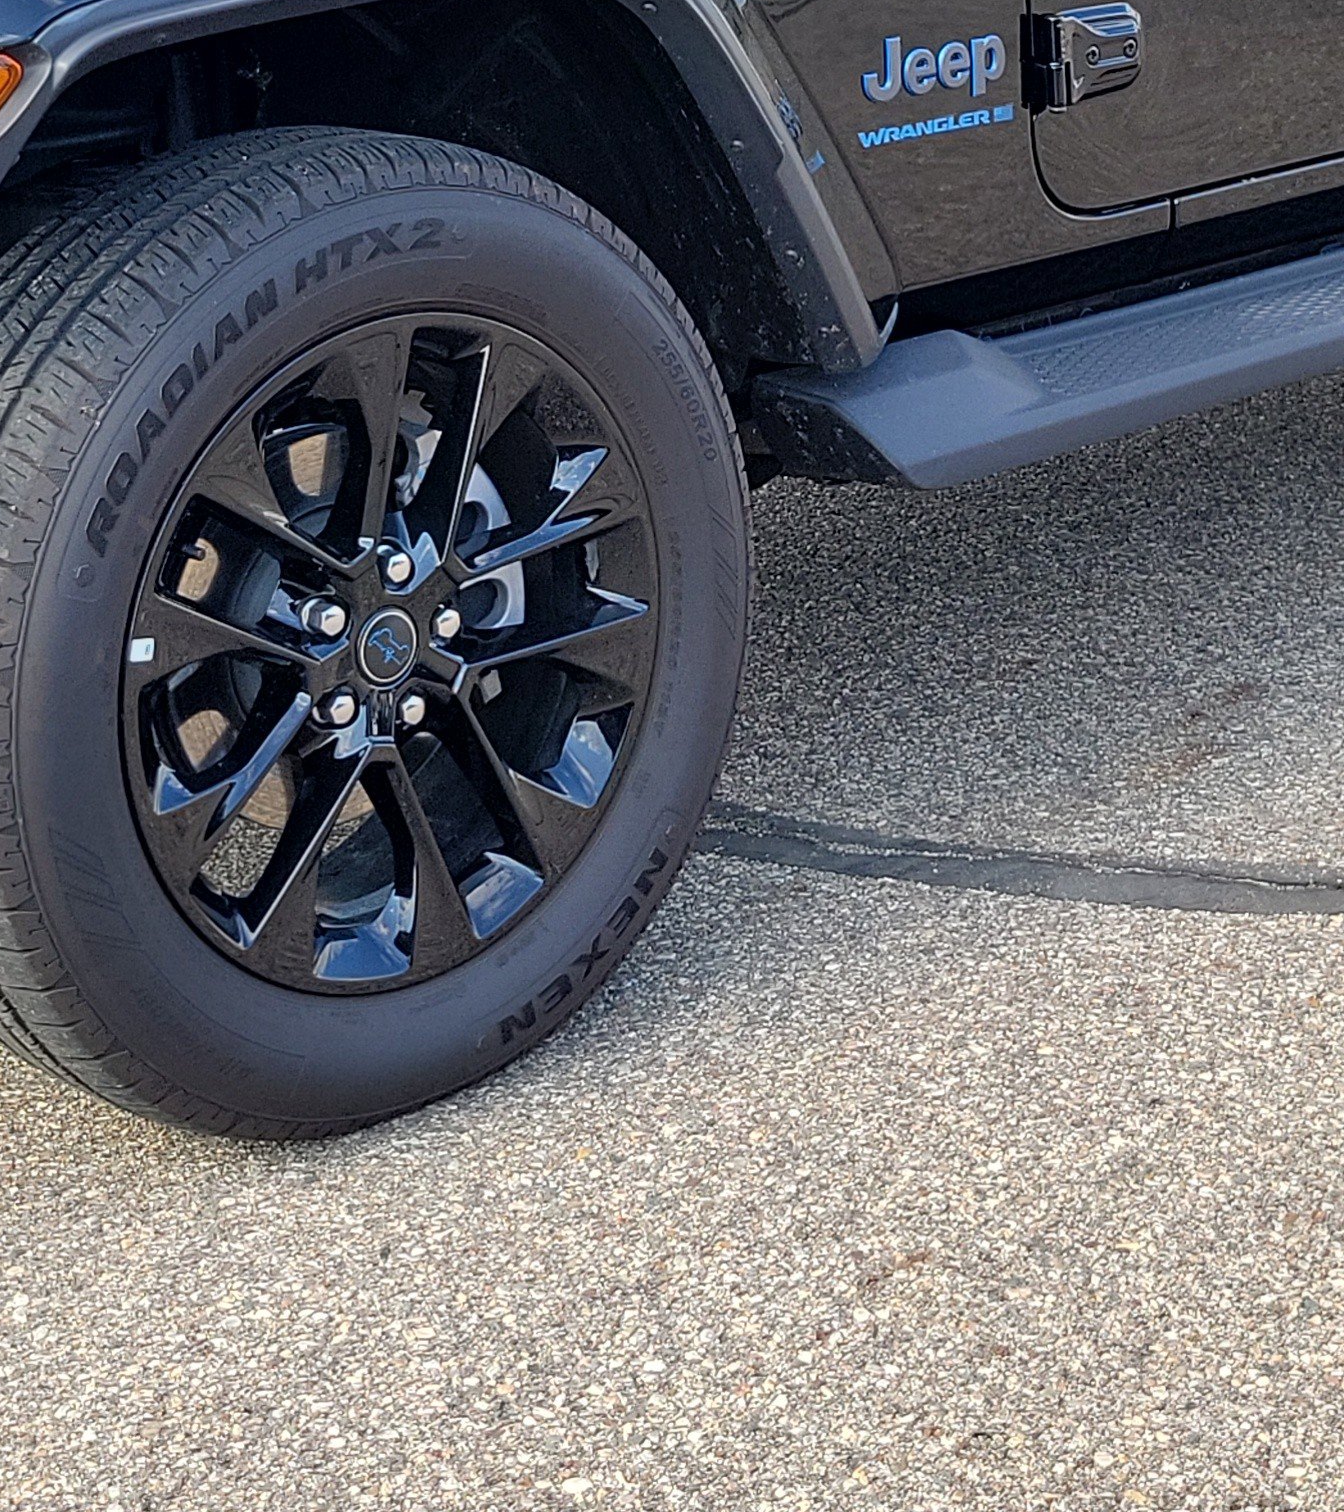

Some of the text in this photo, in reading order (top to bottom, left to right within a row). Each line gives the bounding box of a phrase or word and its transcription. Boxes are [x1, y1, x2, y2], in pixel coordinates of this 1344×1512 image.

[857, 109, 991, 149] WRANGLER
[861, 33, 1006, 103] Jeep
[86, 278, 279, 559] ROADIAN
[498, 846, 669, 1045] NEXEN
